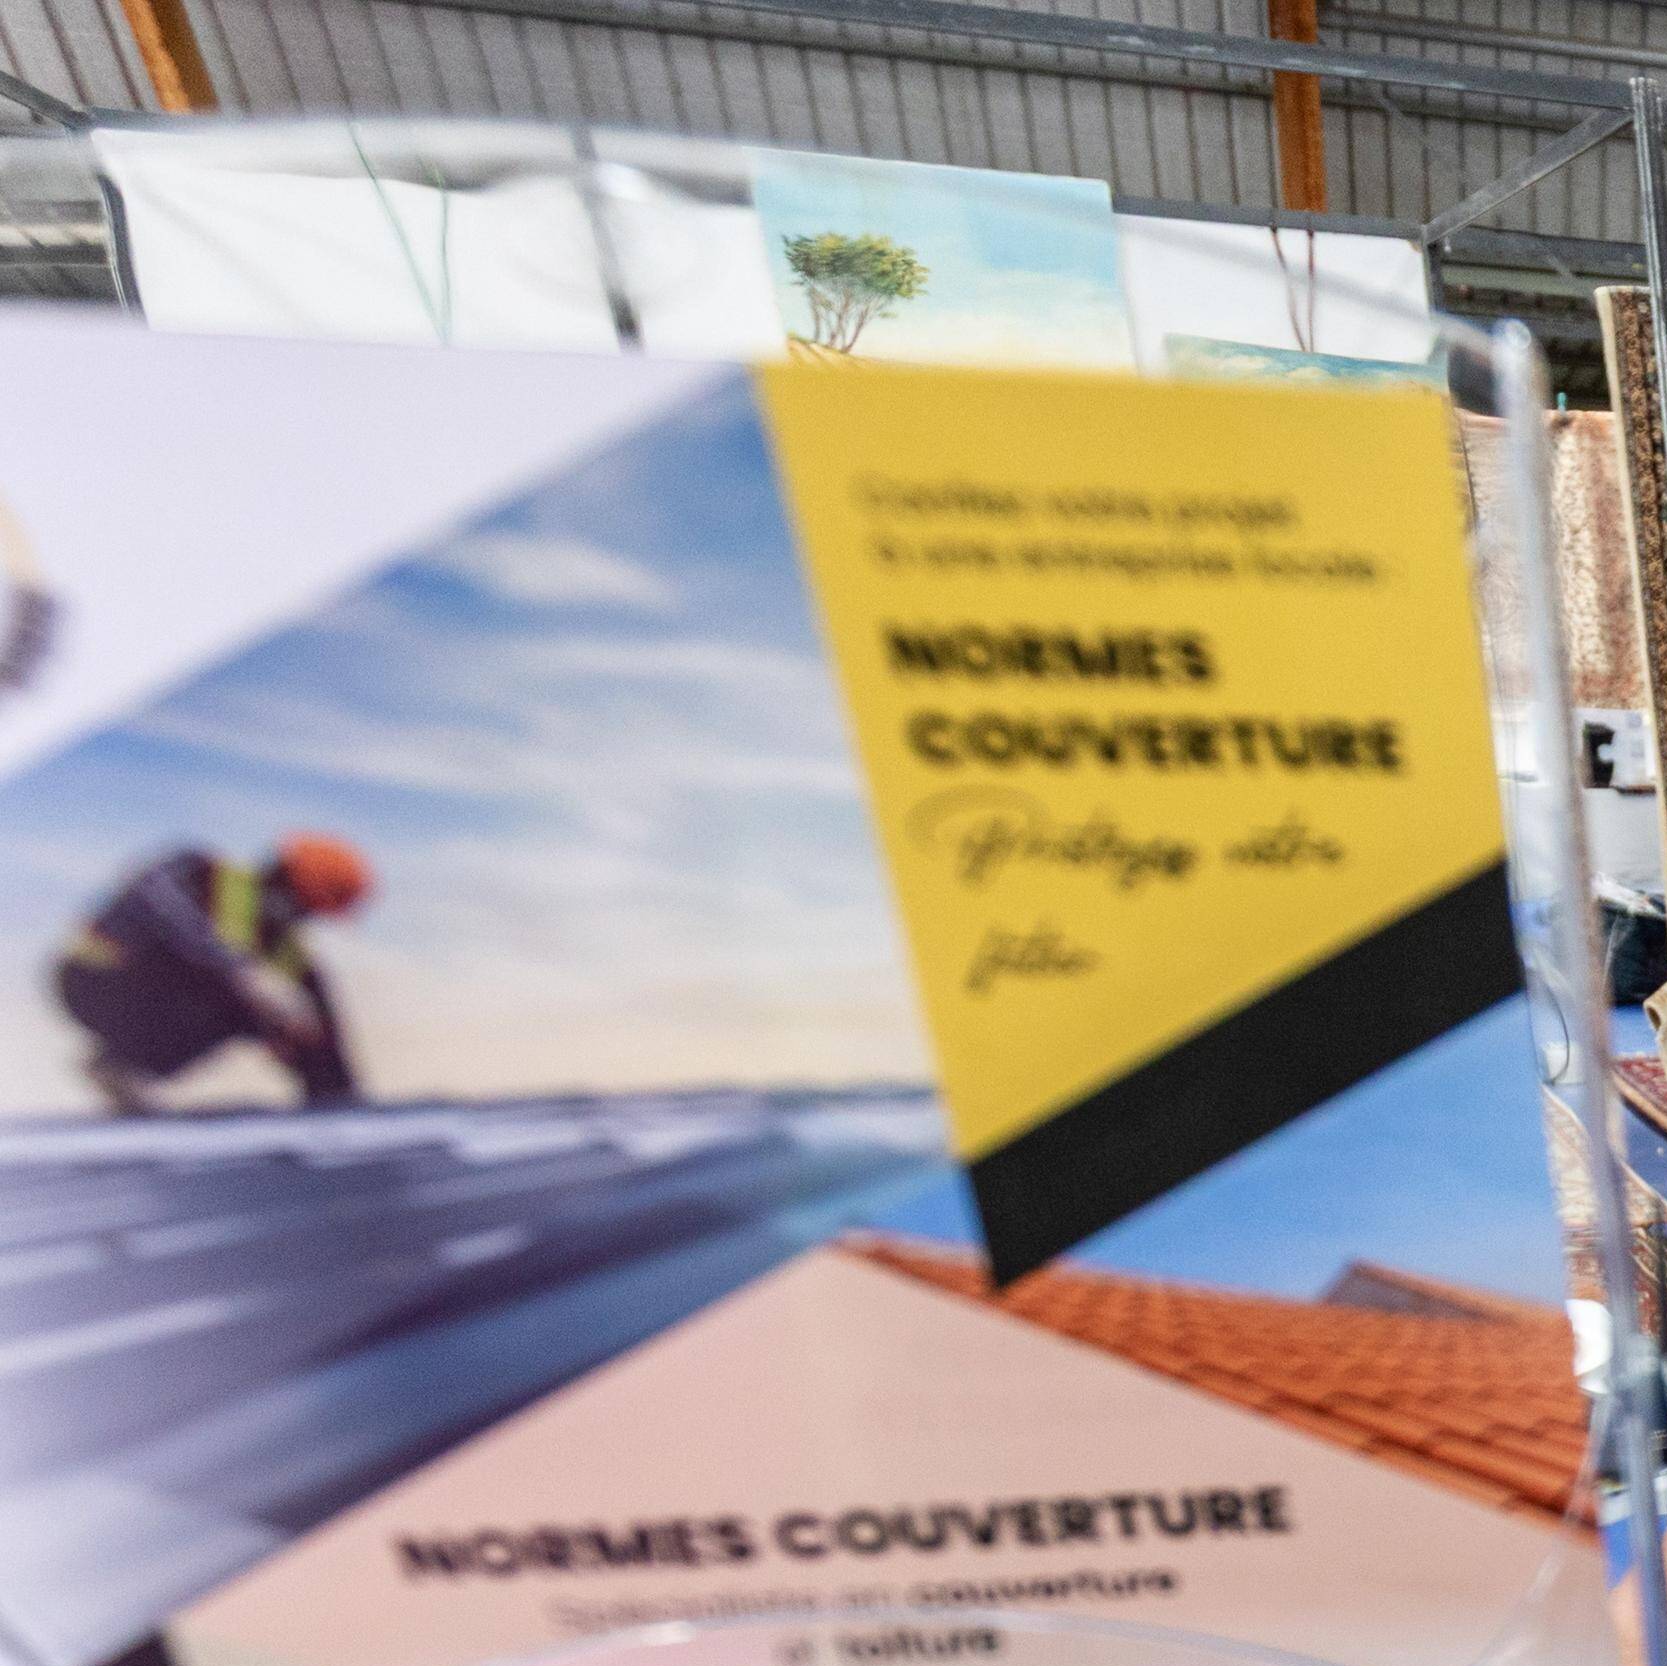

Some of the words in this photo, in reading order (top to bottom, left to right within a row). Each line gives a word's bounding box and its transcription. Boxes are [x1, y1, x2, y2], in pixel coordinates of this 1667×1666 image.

[880, 620, 1218, 684] NORMES
[903, 708, 1408, 775] COUVERTURE
[392, 1514, 757, 1582] NORMES
[774, 1480, 1294, 1561] COUVERTURE
